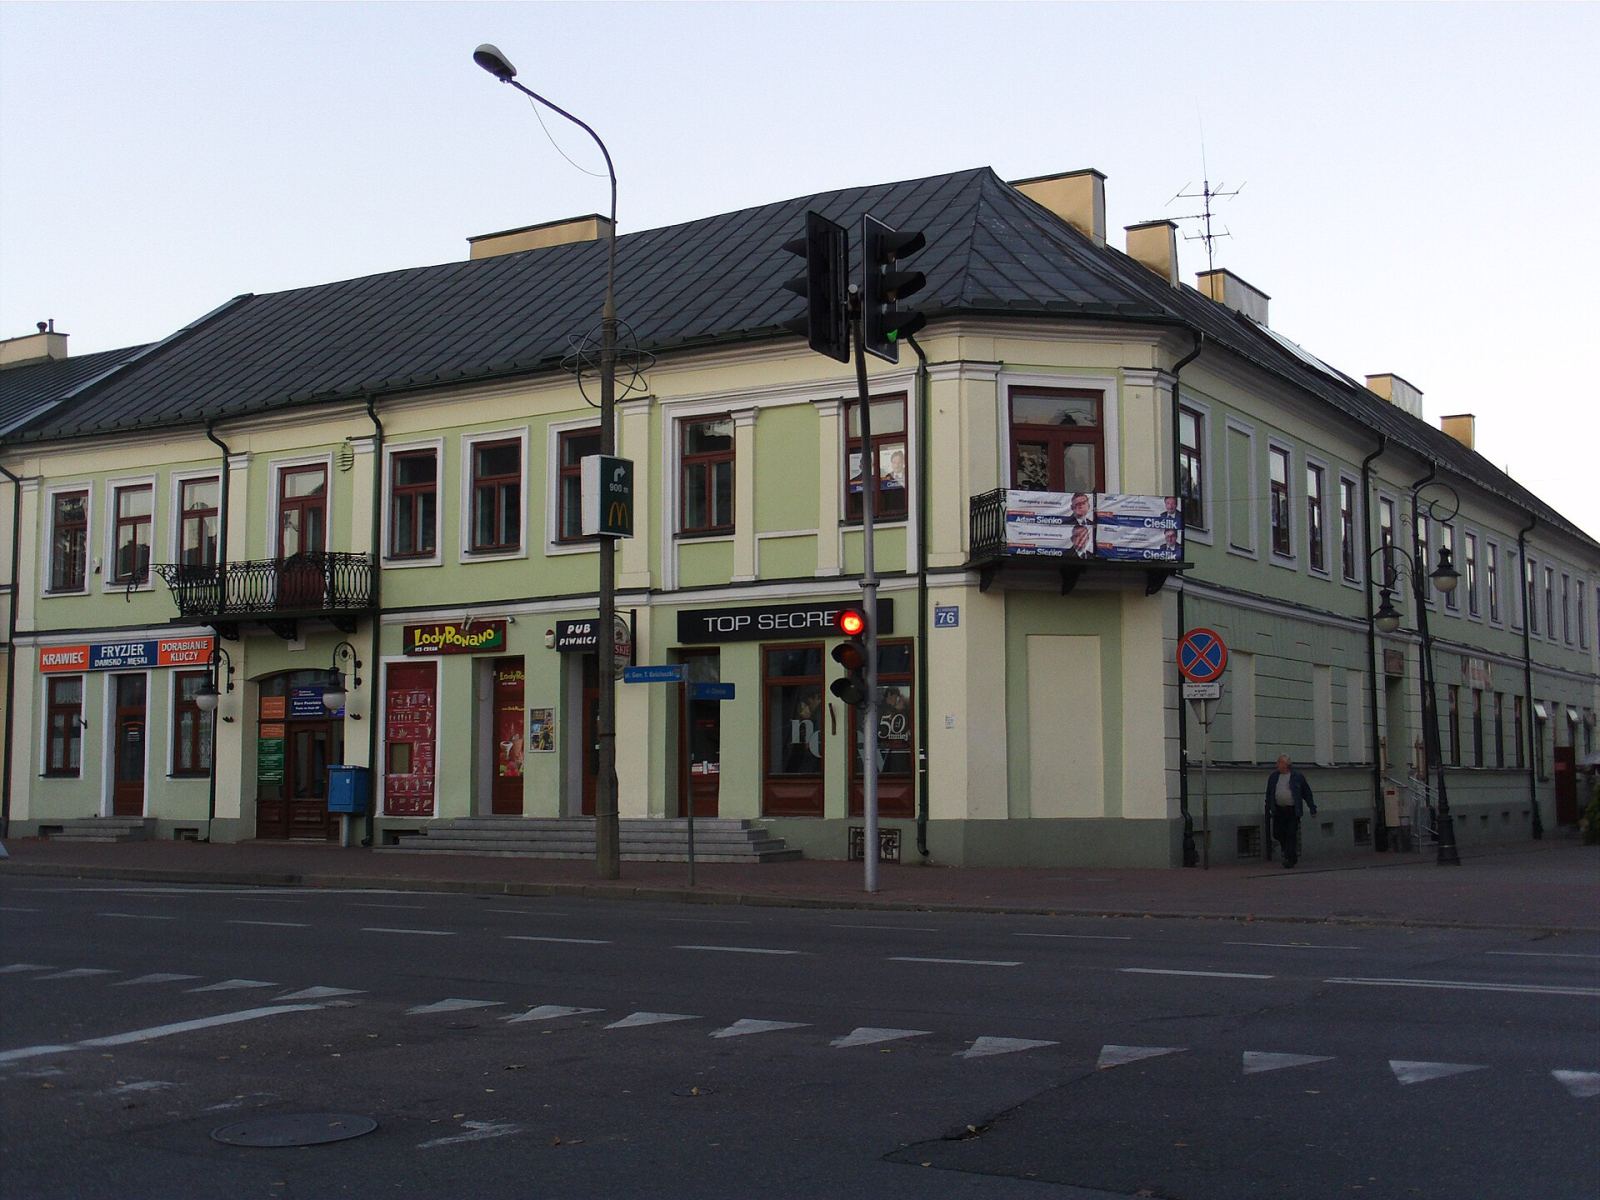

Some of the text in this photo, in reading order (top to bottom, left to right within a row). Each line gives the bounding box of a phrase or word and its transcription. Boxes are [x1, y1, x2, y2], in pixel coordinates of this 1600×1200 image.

[1143, 518, 1177, 530] Cieślik
[703, 610, 843, 632] TOP SECRE
[938, 612, 955, 623] 76
[567, 624, 591, 635] PUB
[101, 644, 145, 657] FRYZJER
[162, 640, 208, 652] DORABIANIE
[614, 644, 631, 655] SKIE
[42, 652, 83, 665] KRAWIEC
[95, 658, 121, 667] DAMSKO
[127, 657, 147, 666] MĘSKI
[171, 652, 198, 662] KLUCZY
[878, 714, 906, 738] 50
